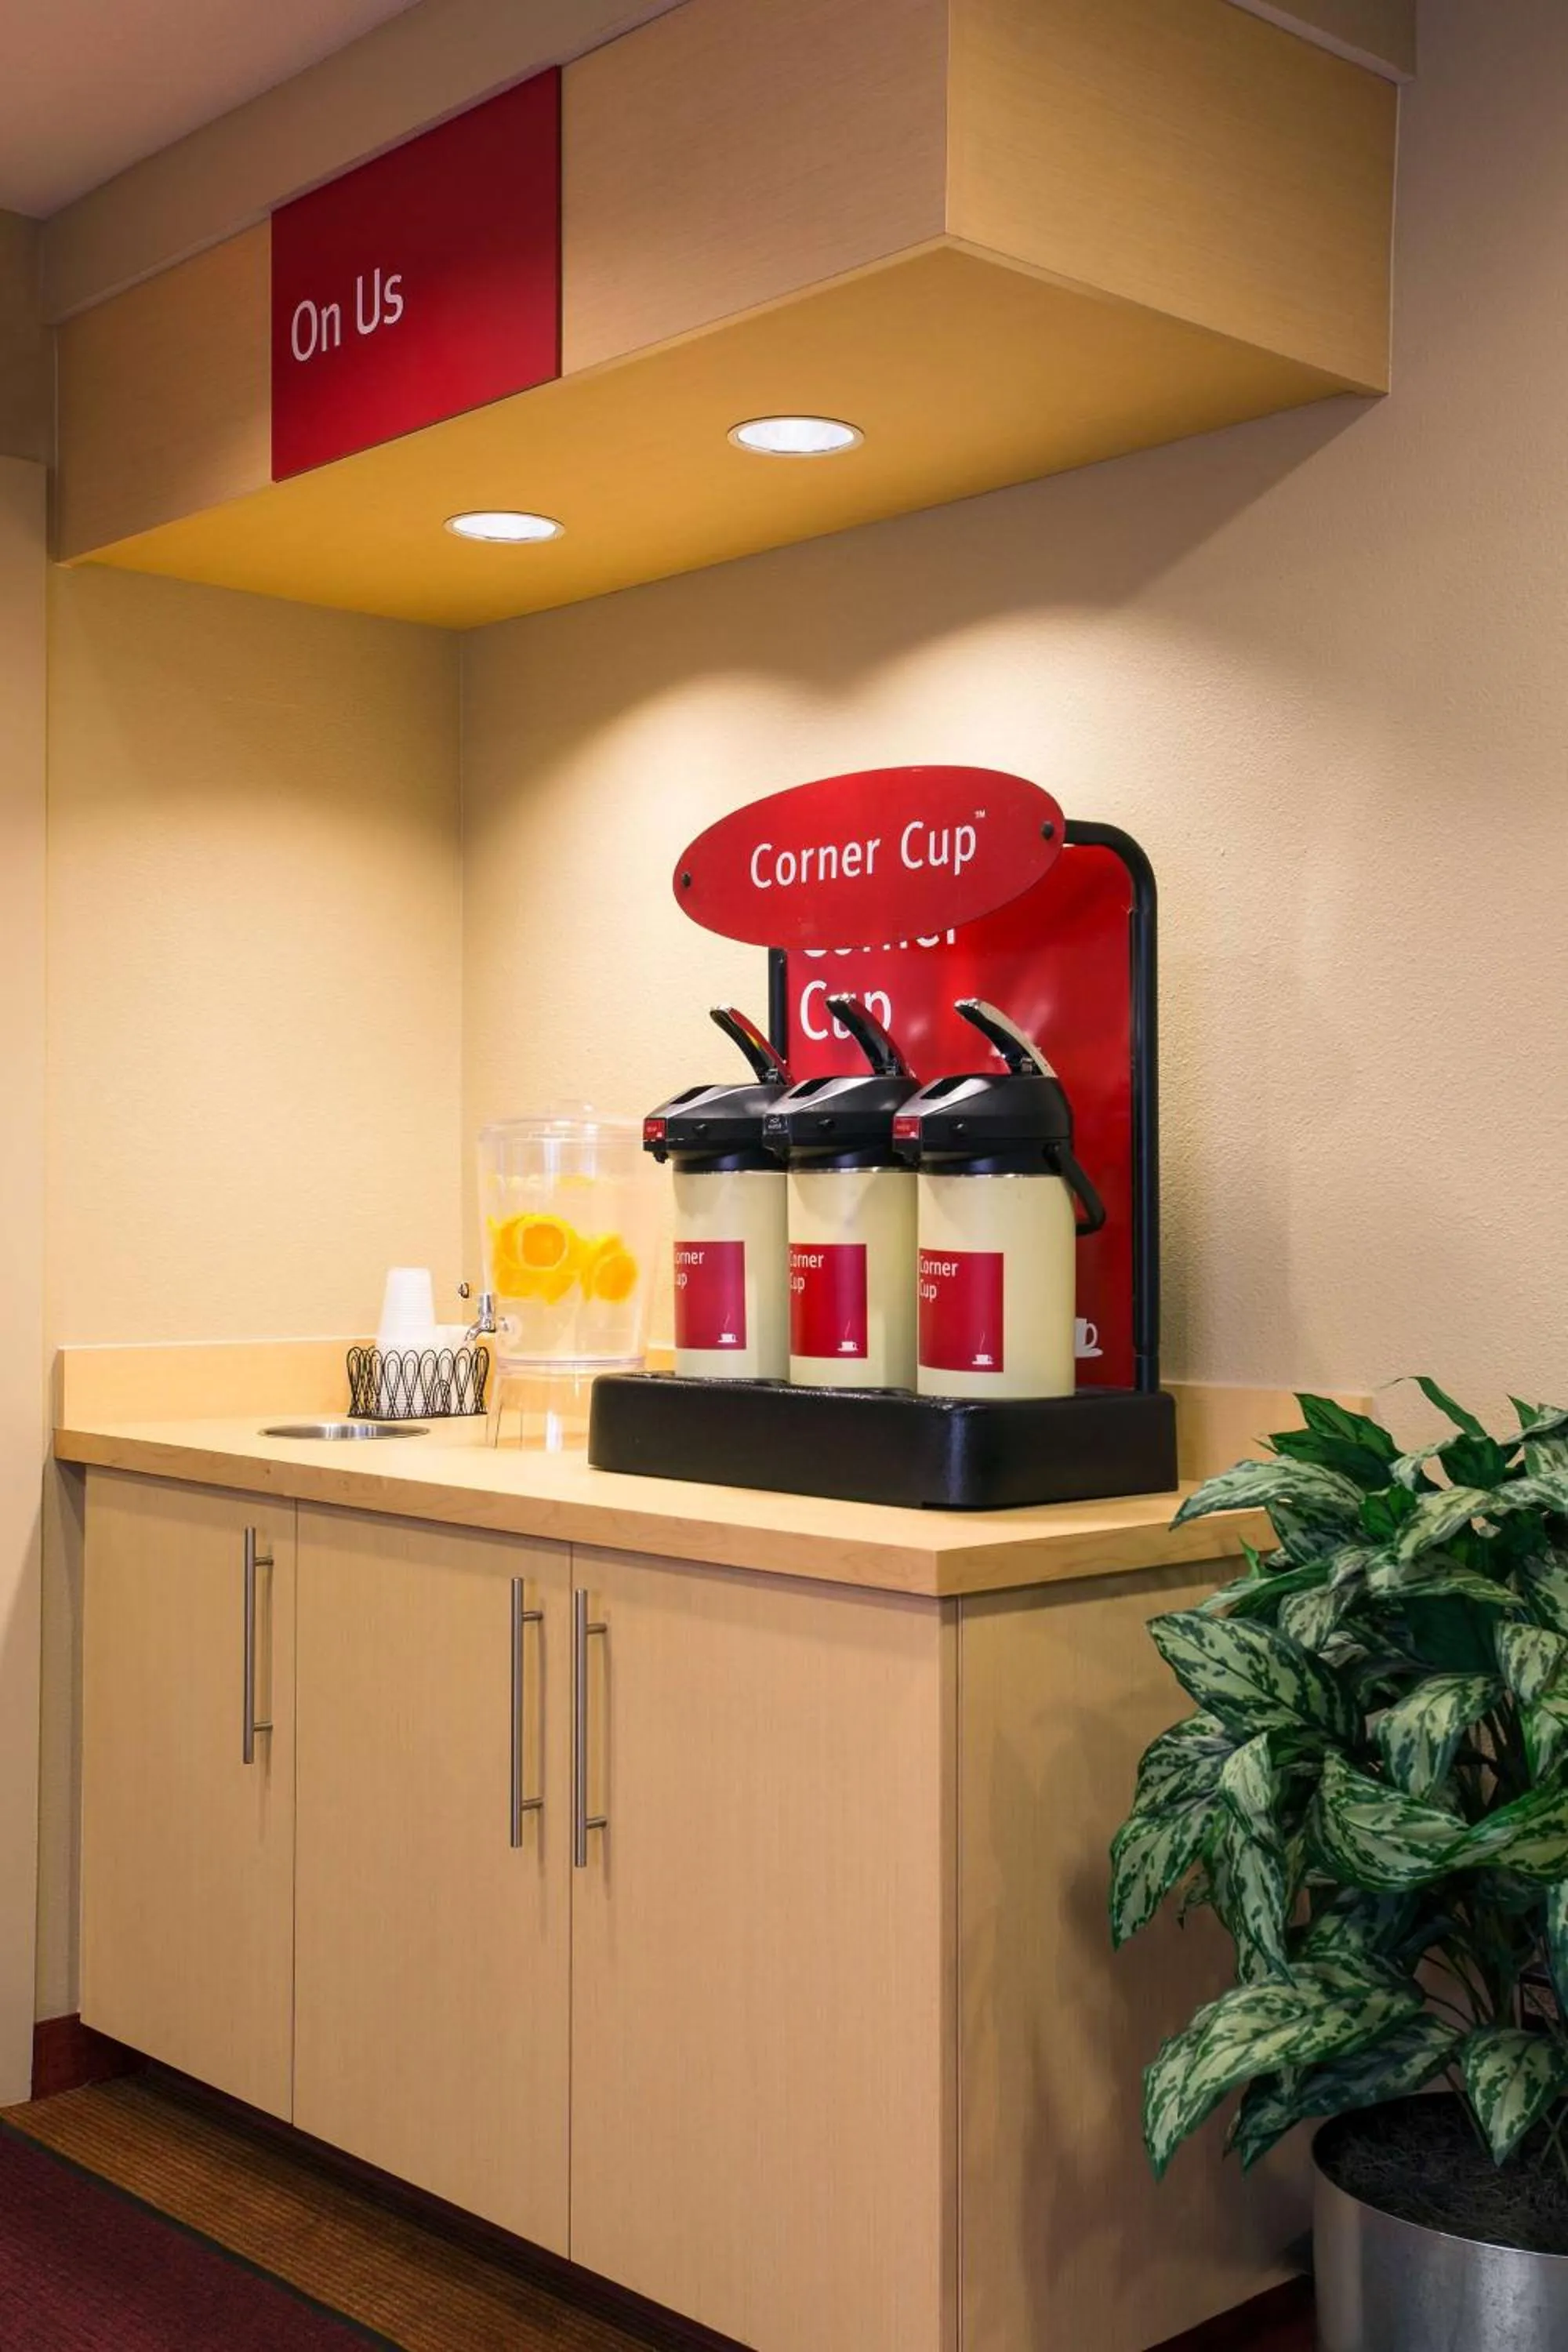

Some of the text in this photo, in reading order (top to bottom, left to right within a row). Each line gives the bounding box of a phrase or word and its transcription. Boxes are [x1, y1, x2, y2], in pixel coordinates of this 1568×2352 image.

[291, 267, 404, 361] On Us
[750, 821, 976, 888] Corner Cup
[675, 1250, 705, 1265] orner
